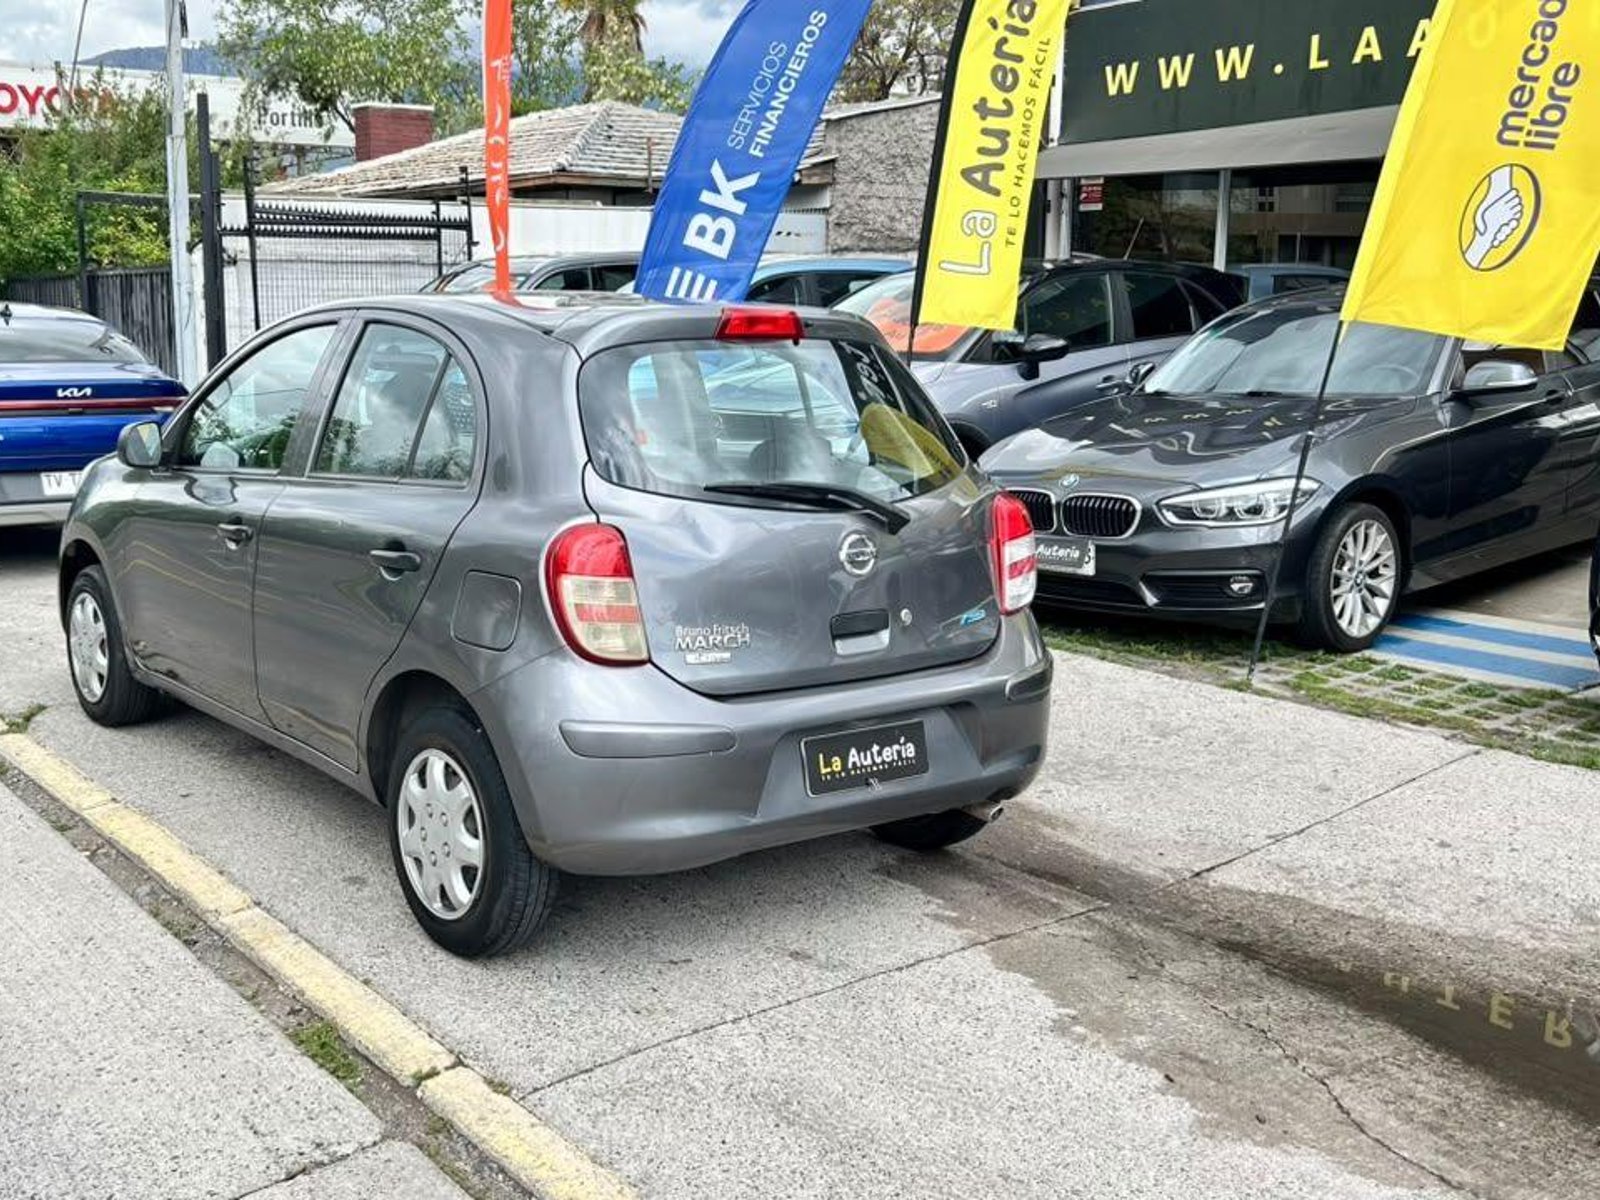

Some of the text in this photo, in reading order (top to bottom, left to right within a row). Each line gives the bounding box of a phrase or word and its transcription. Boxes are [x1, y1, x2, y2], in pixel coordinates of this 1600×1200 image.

[727, 41, 787, 150] SERVICIOS
[749, 10, 828, 158] FINANCIEROS
[1523, 62, 1581, 150] libre
[1005, 37, 1052, 248] TE LO HACEMOS FÁCIL
[683, 158, 761, 260] BK
[939, 209, 997, 276] La
[675, 632, 751, 651] MARCH
[818, 753, 842, 775] La
[847, 736, 916, 769] Autería
